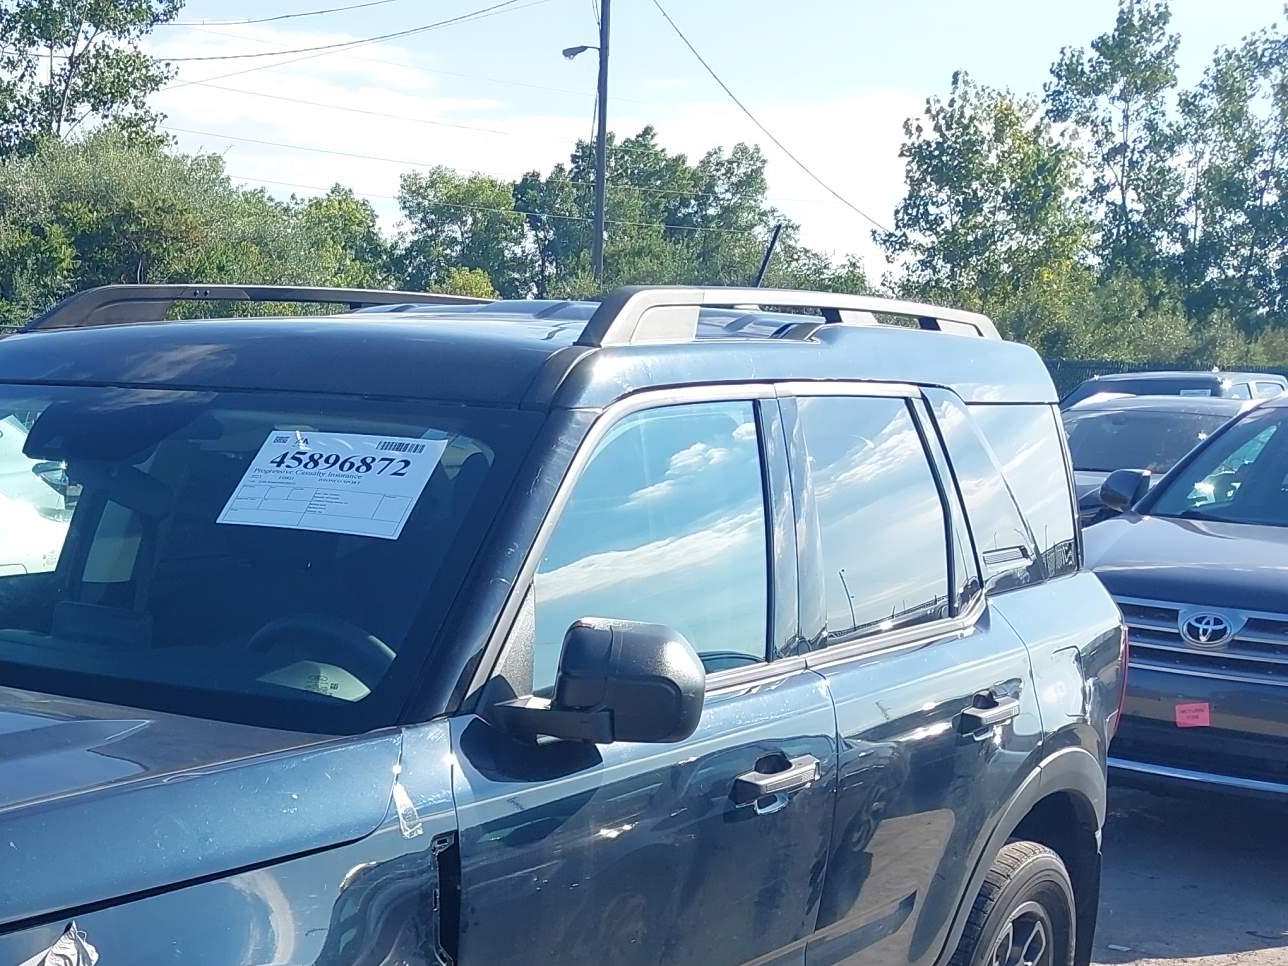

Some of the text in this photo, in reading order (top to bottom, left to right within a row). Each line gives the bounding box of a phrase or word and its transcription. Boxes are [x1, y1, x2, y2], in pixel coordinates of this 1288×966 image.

[253, 467, 363, 480] Progressive Casualty Insurance
[270, 451, 411, 477] 45896872
